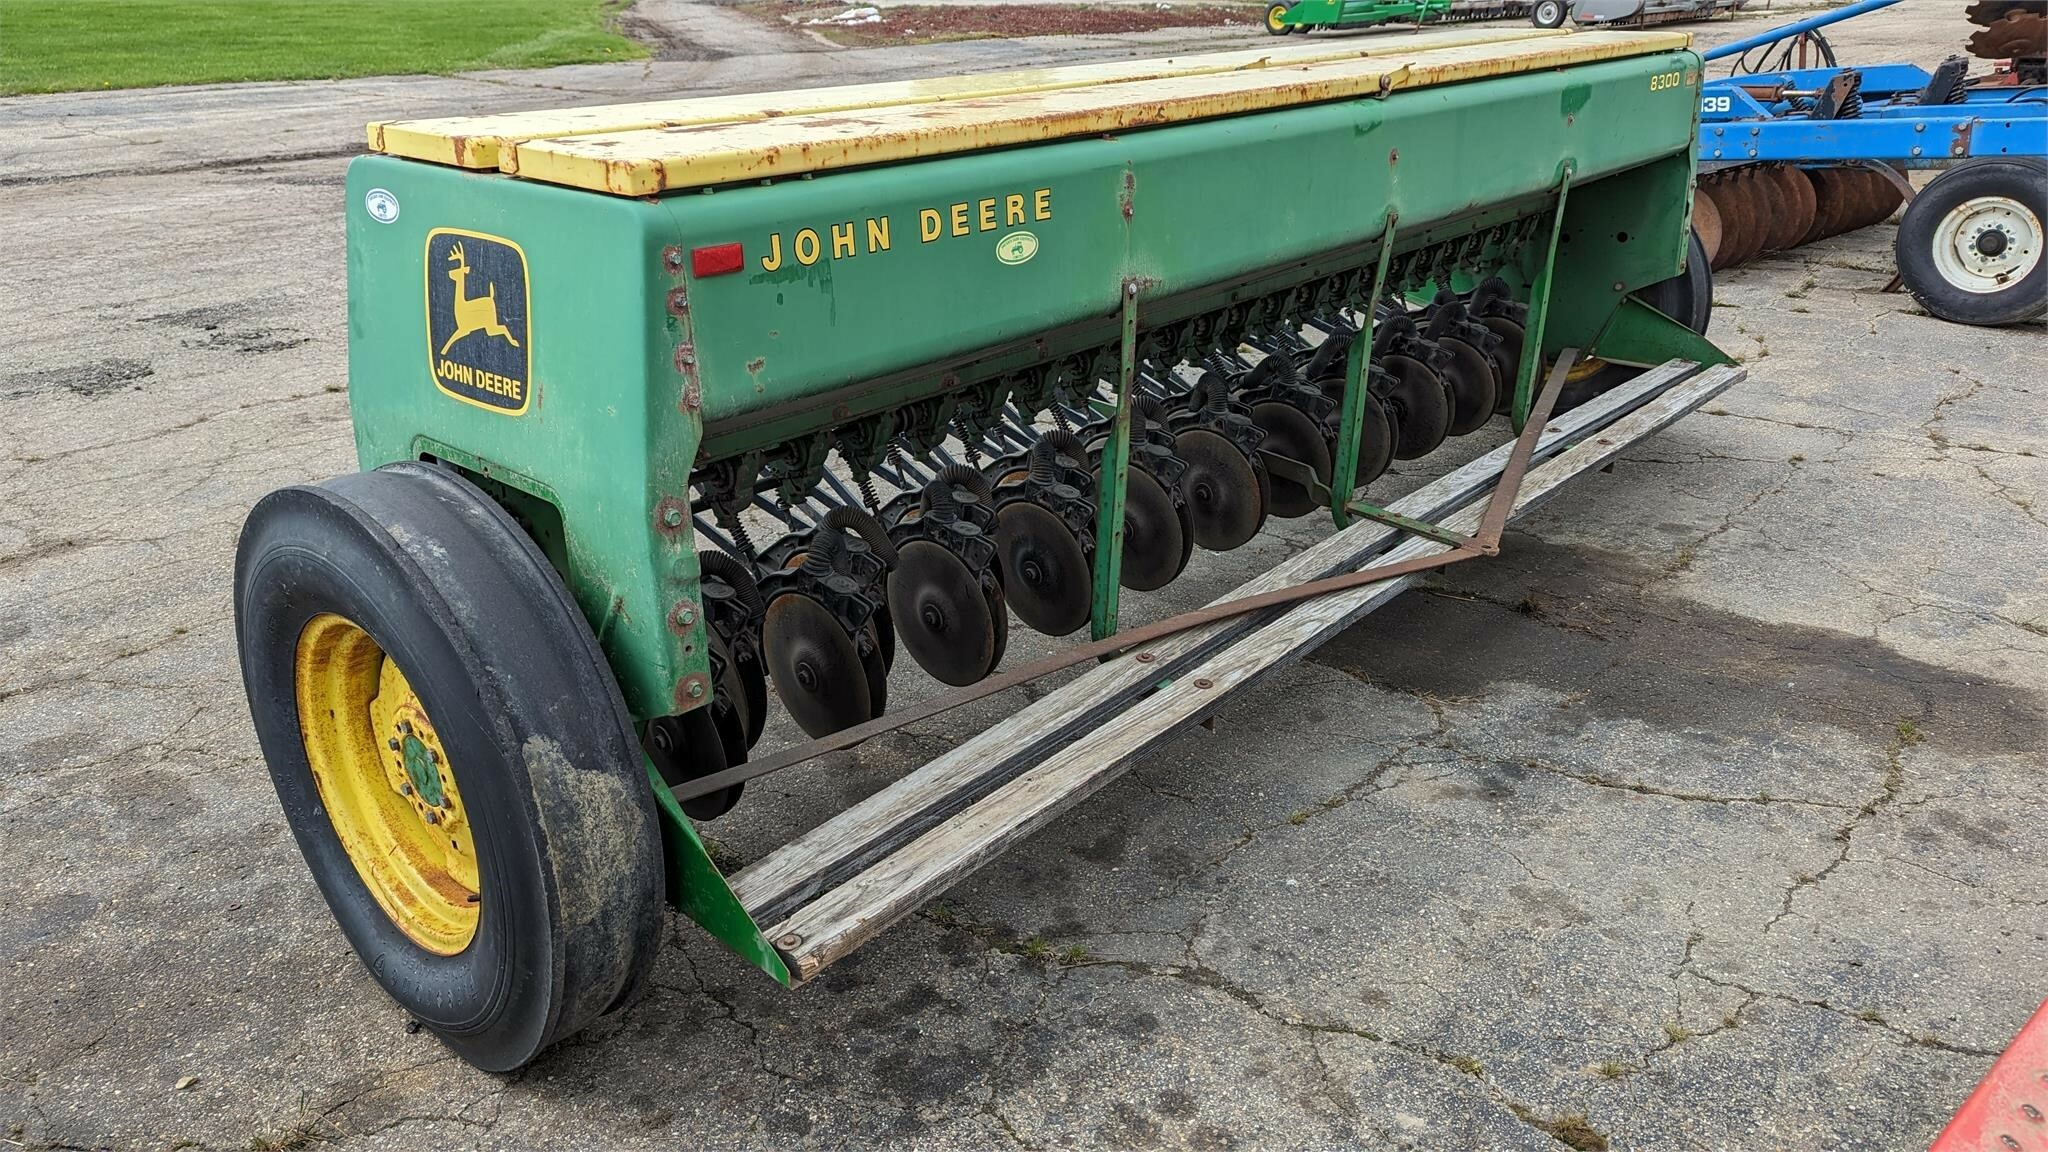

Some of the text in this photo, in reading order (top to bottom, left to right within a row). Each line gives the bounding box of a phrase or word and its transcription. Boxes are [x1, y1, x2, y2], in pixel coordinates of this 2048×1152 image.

[1650, 72, 1680, 91] 8300
[761, 188, 1053, 272] JOHN DEERE
[437, 359, 521, 400] JOHN DEERE
